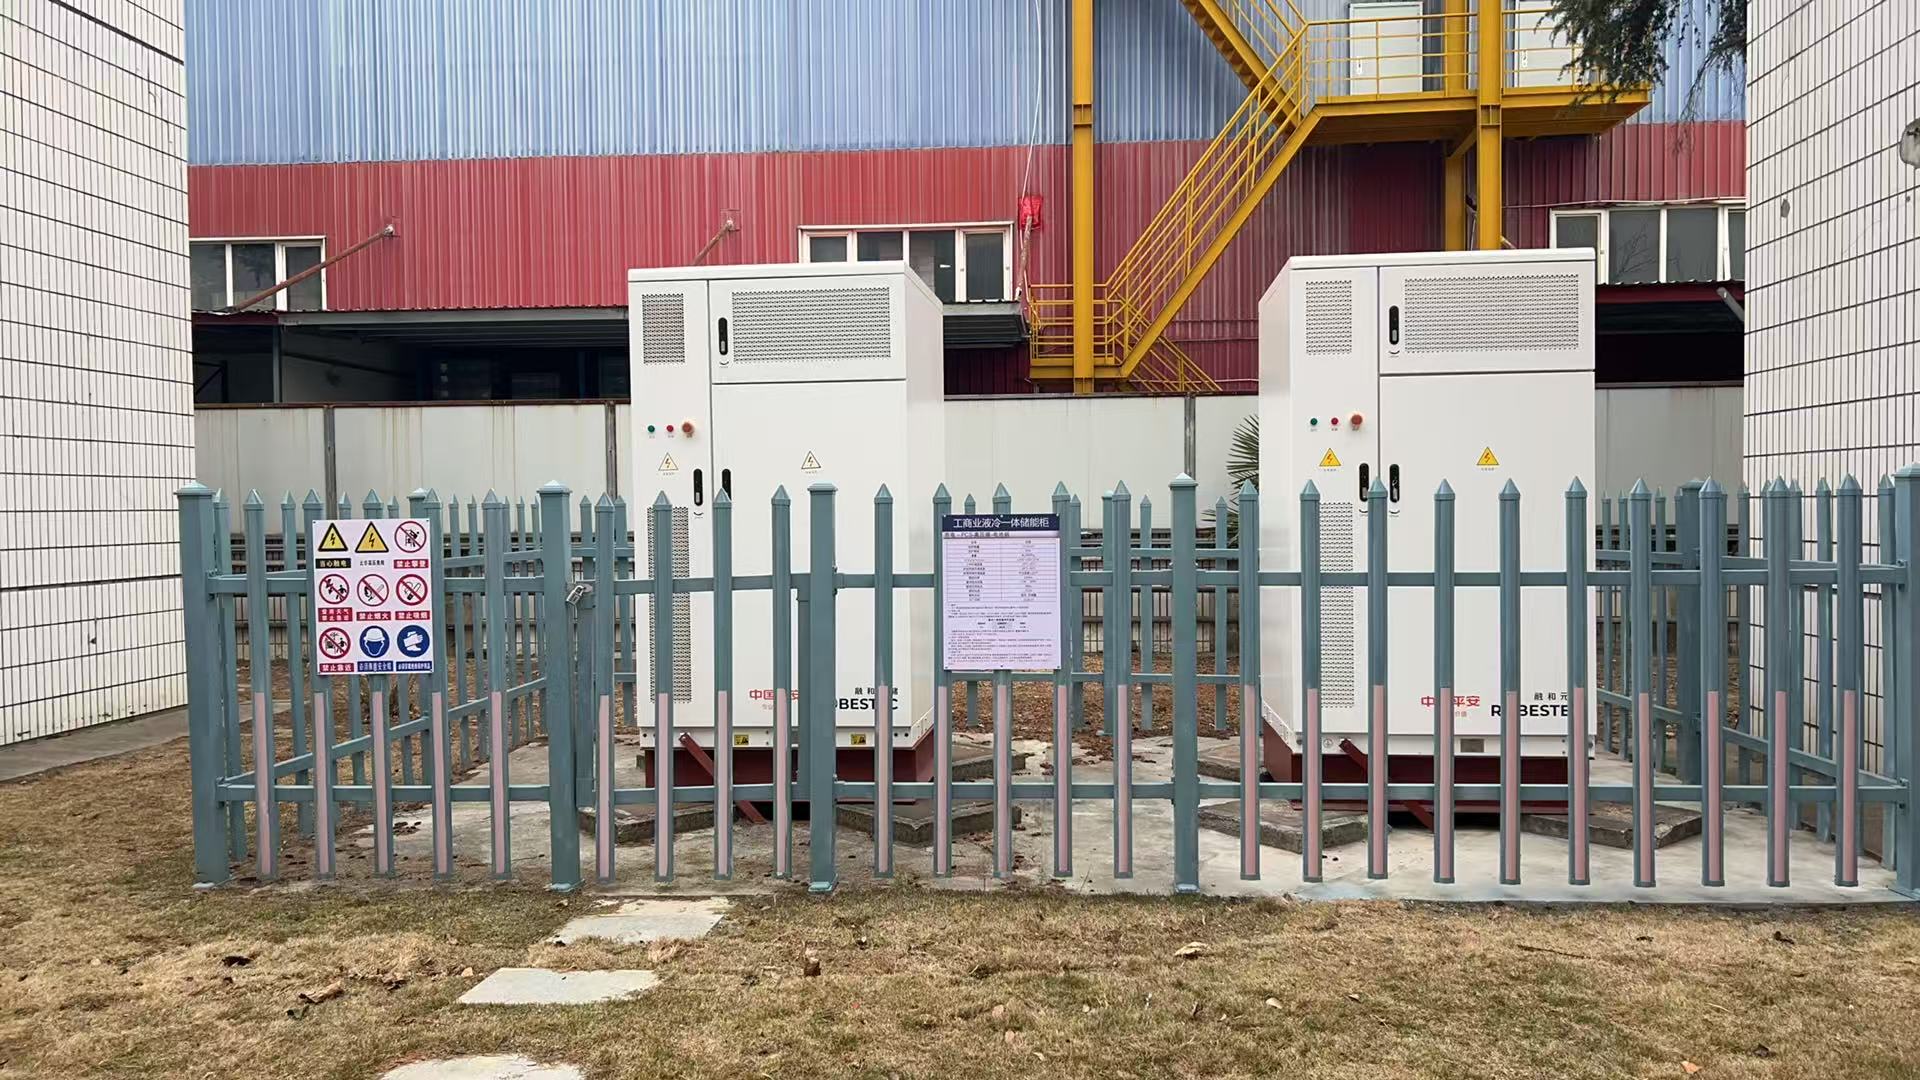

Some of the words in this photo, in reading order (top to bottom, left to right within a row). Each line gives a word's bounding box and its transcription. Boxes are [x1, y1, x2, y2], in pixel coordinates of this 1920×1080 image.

[953, 517, 1050, 529] 工商业液冷一体储能柜
[749, 689, 799, 700] 中国安
[1534, 691, 1568, 701] 融和元
[1421, 695, 1480, 708] 中平安
[1491, 704, 1568, 717] RBESTE
